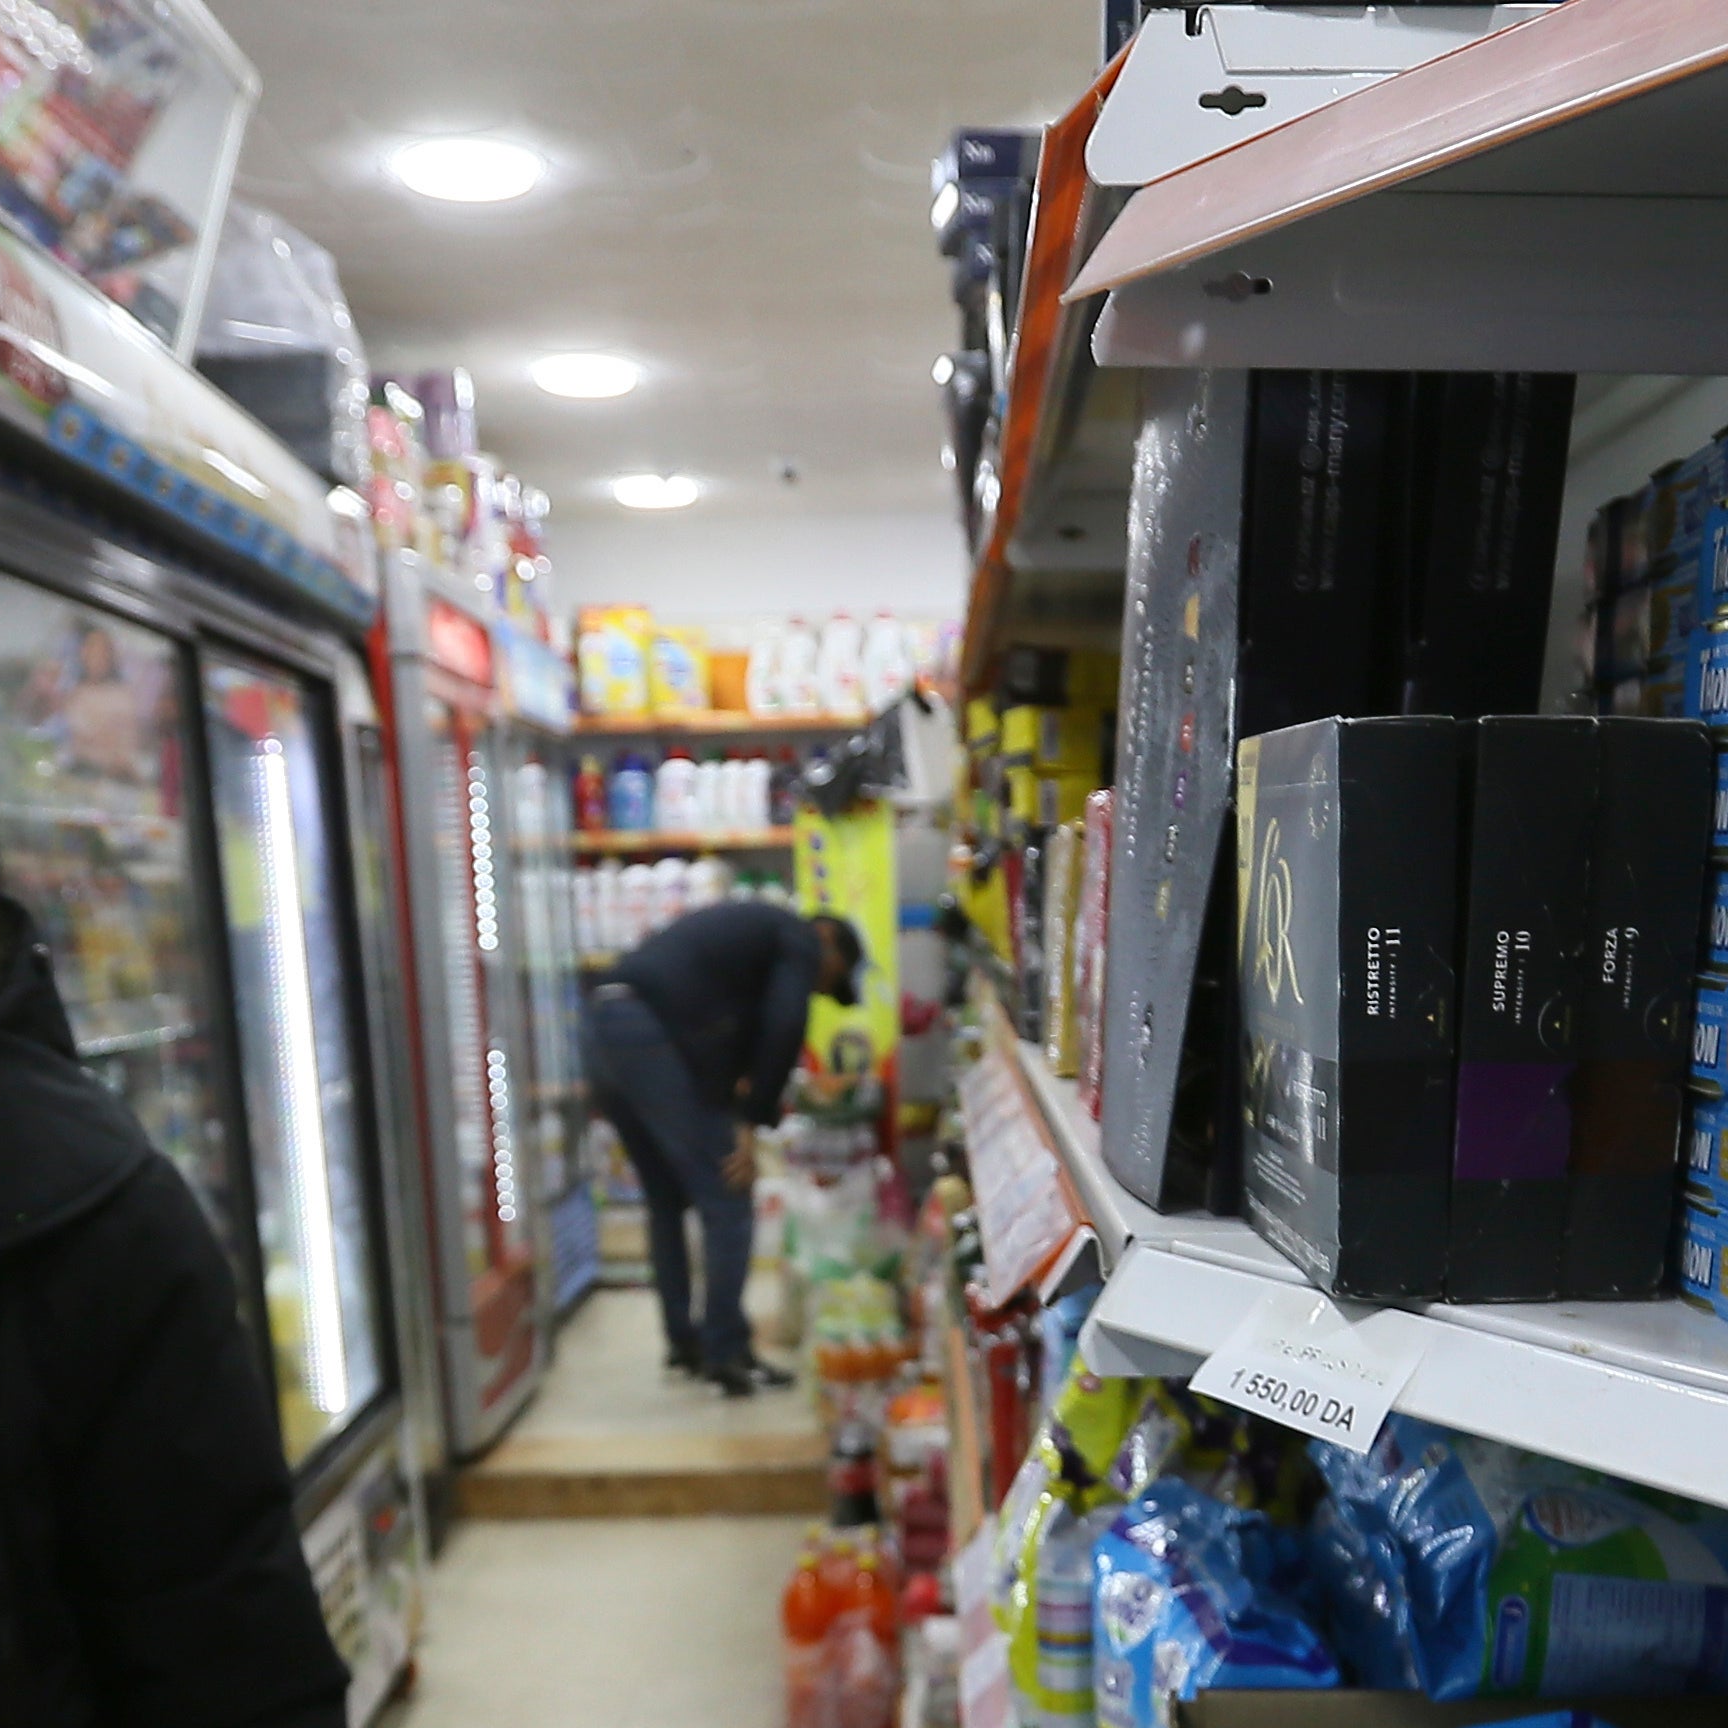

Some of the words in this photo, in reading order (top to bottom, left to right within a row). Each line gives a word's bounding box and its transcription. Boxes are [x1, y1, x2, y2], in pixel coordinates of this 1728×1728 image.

[1385, 928, 1401, 946] 11
[1514, 930, 1531, 951] 10
[1602, 927, 1618, 984] FORZA
[1624, 926, 1640, 940] 9
[1367, 927, 1380, 1016] RISTRETTO
[1492, 930, 1511, 1012] SUPREMO
[1245, 1374, 1320, 1418] 550,00
[1320, 1398, 1357, 1433] DA
